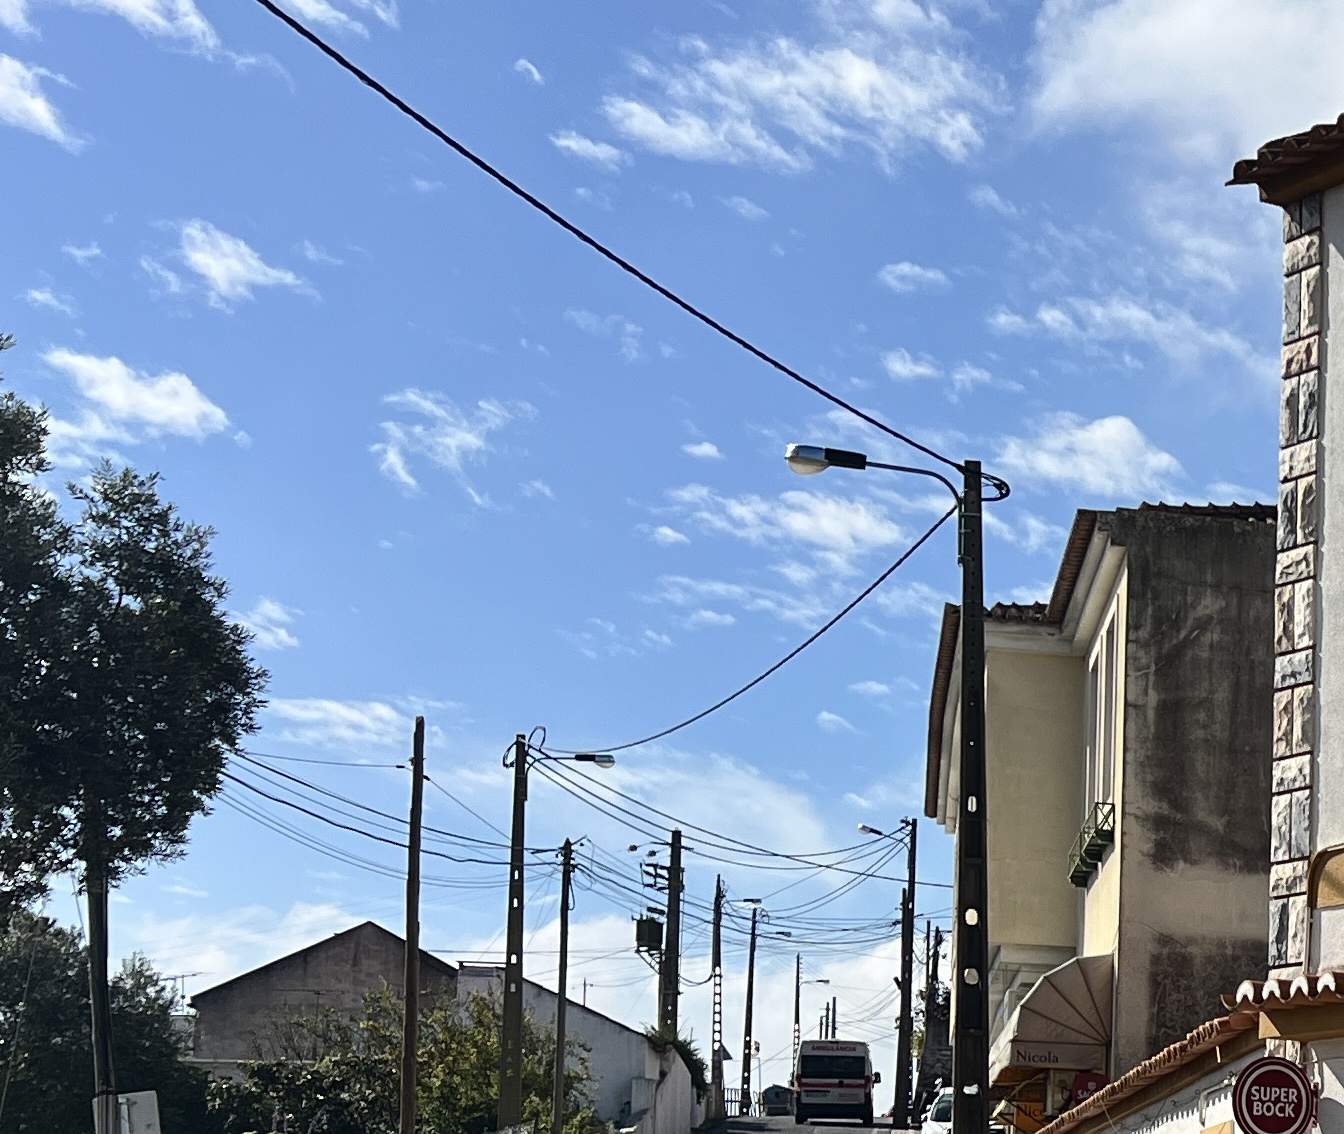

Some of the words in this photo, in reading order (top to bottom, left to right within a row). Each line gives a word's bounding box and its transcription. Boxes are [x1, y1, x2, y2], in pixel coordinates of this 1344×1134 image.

[1016, 1049, 1059, 1064] Nicola
[1251, 1086, 1298, 1103] SUPER
[1253, 1101, 1295, 1118] BOCK
